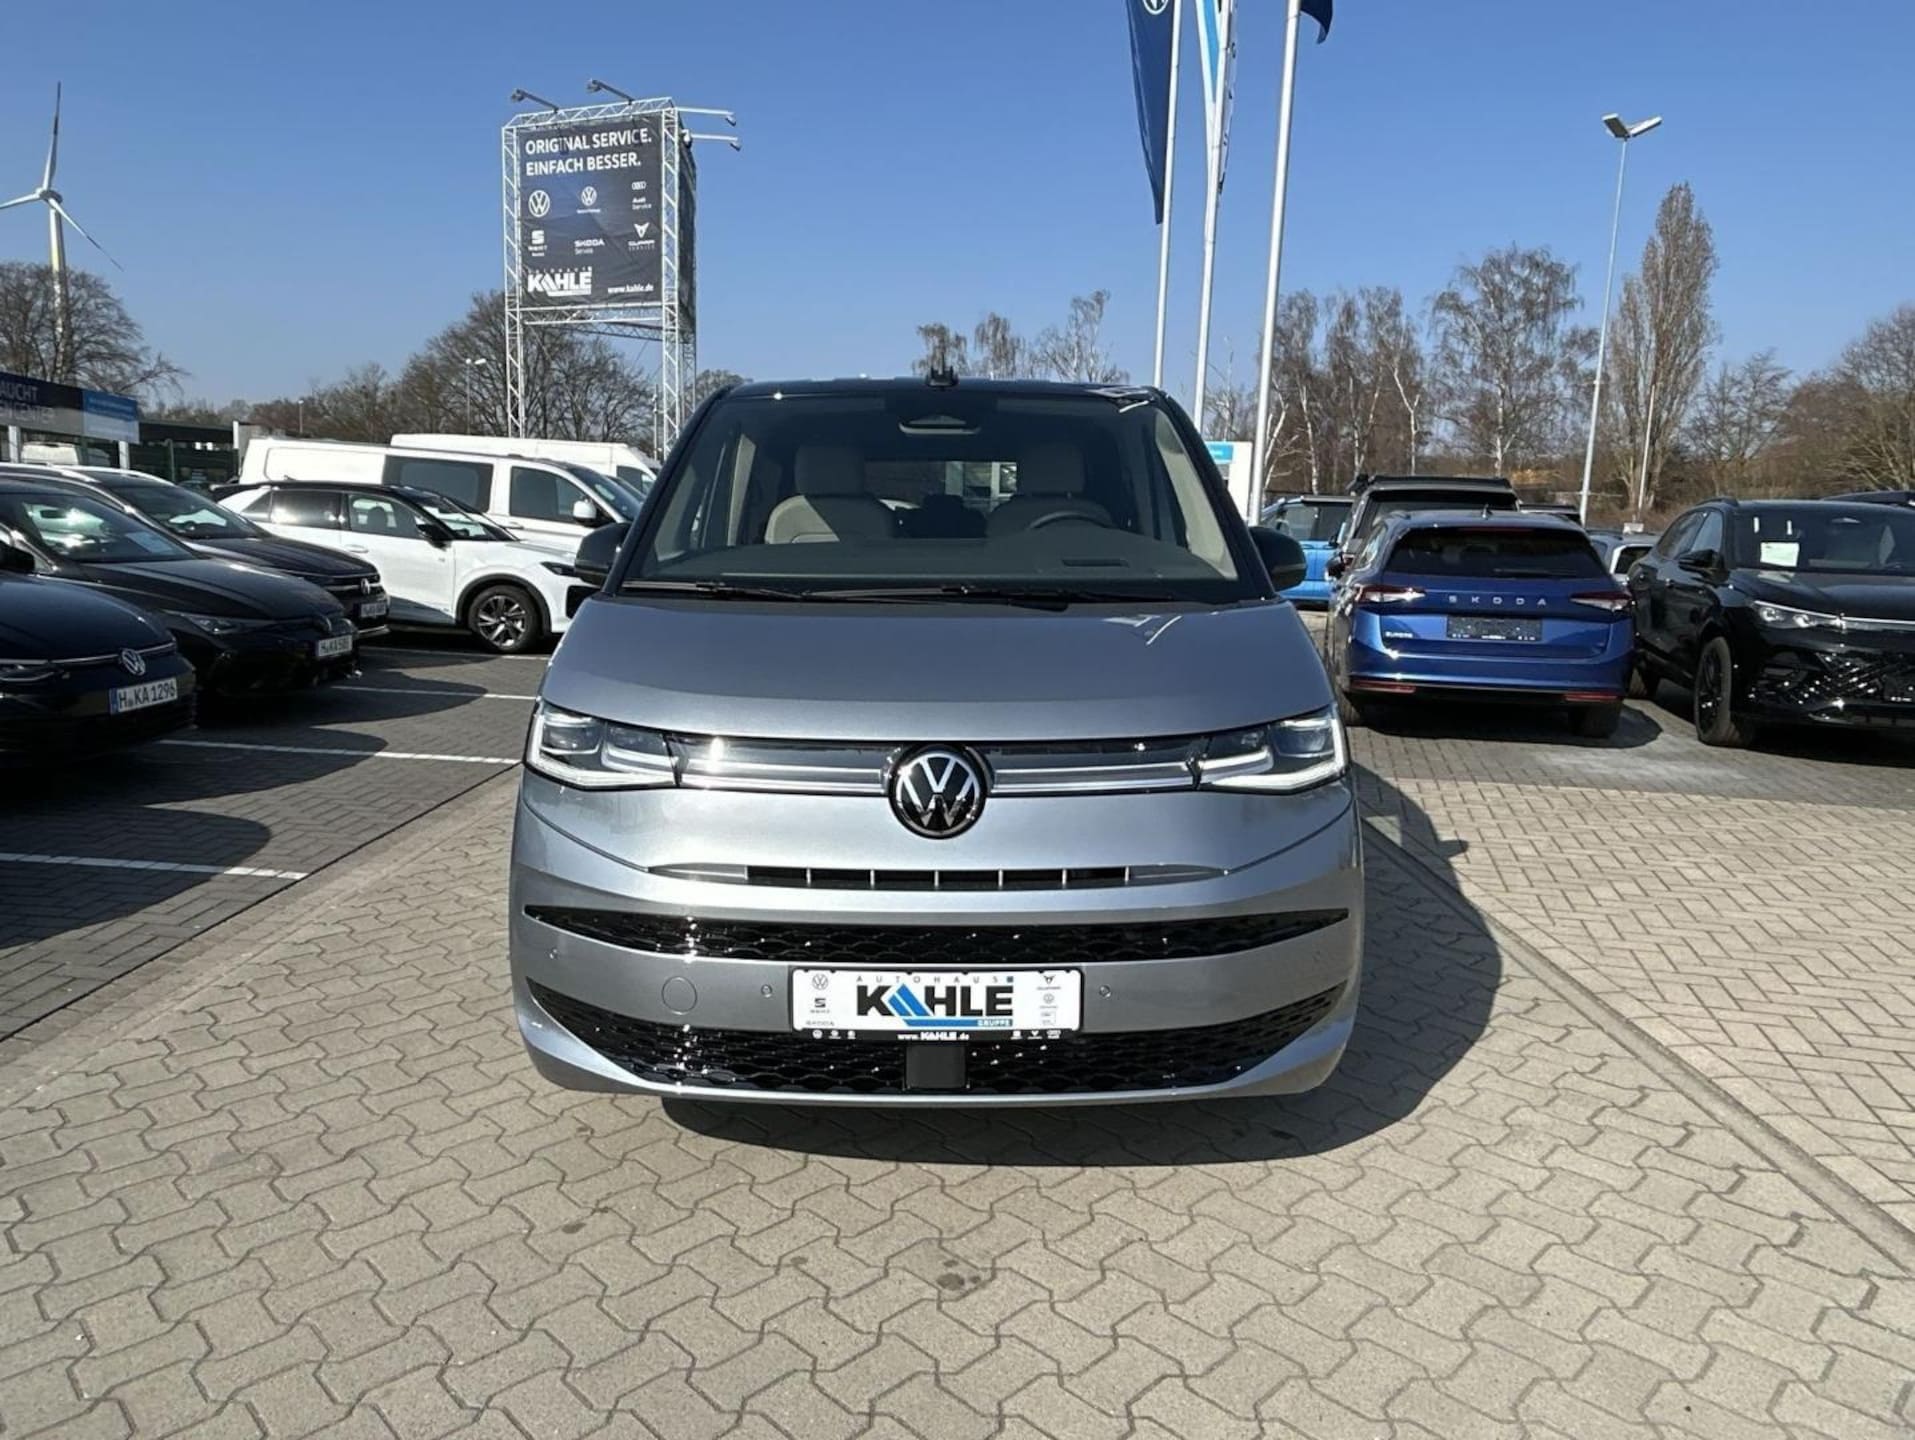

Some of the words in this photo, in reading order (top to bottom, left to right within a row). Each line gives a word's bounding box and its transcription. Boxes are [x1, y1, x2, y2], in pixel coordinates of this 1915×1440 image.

[525, 134, 590, 155] ORIGINAL
[592, 127, 652, 149] SERVICE.
[526, 157, 584, 176] EINFACH
[586, 151, 641, 171] BESSER.
[527, 271, 592, 293] KAHLE
[608, 283, 654, 294] www.kahle.de
[856, 975, 999, 984] AUTOHAUS
[856, 984, 1014, 1017] KAHLE
[976, 1018, 1012, 1028] GRUPPE
